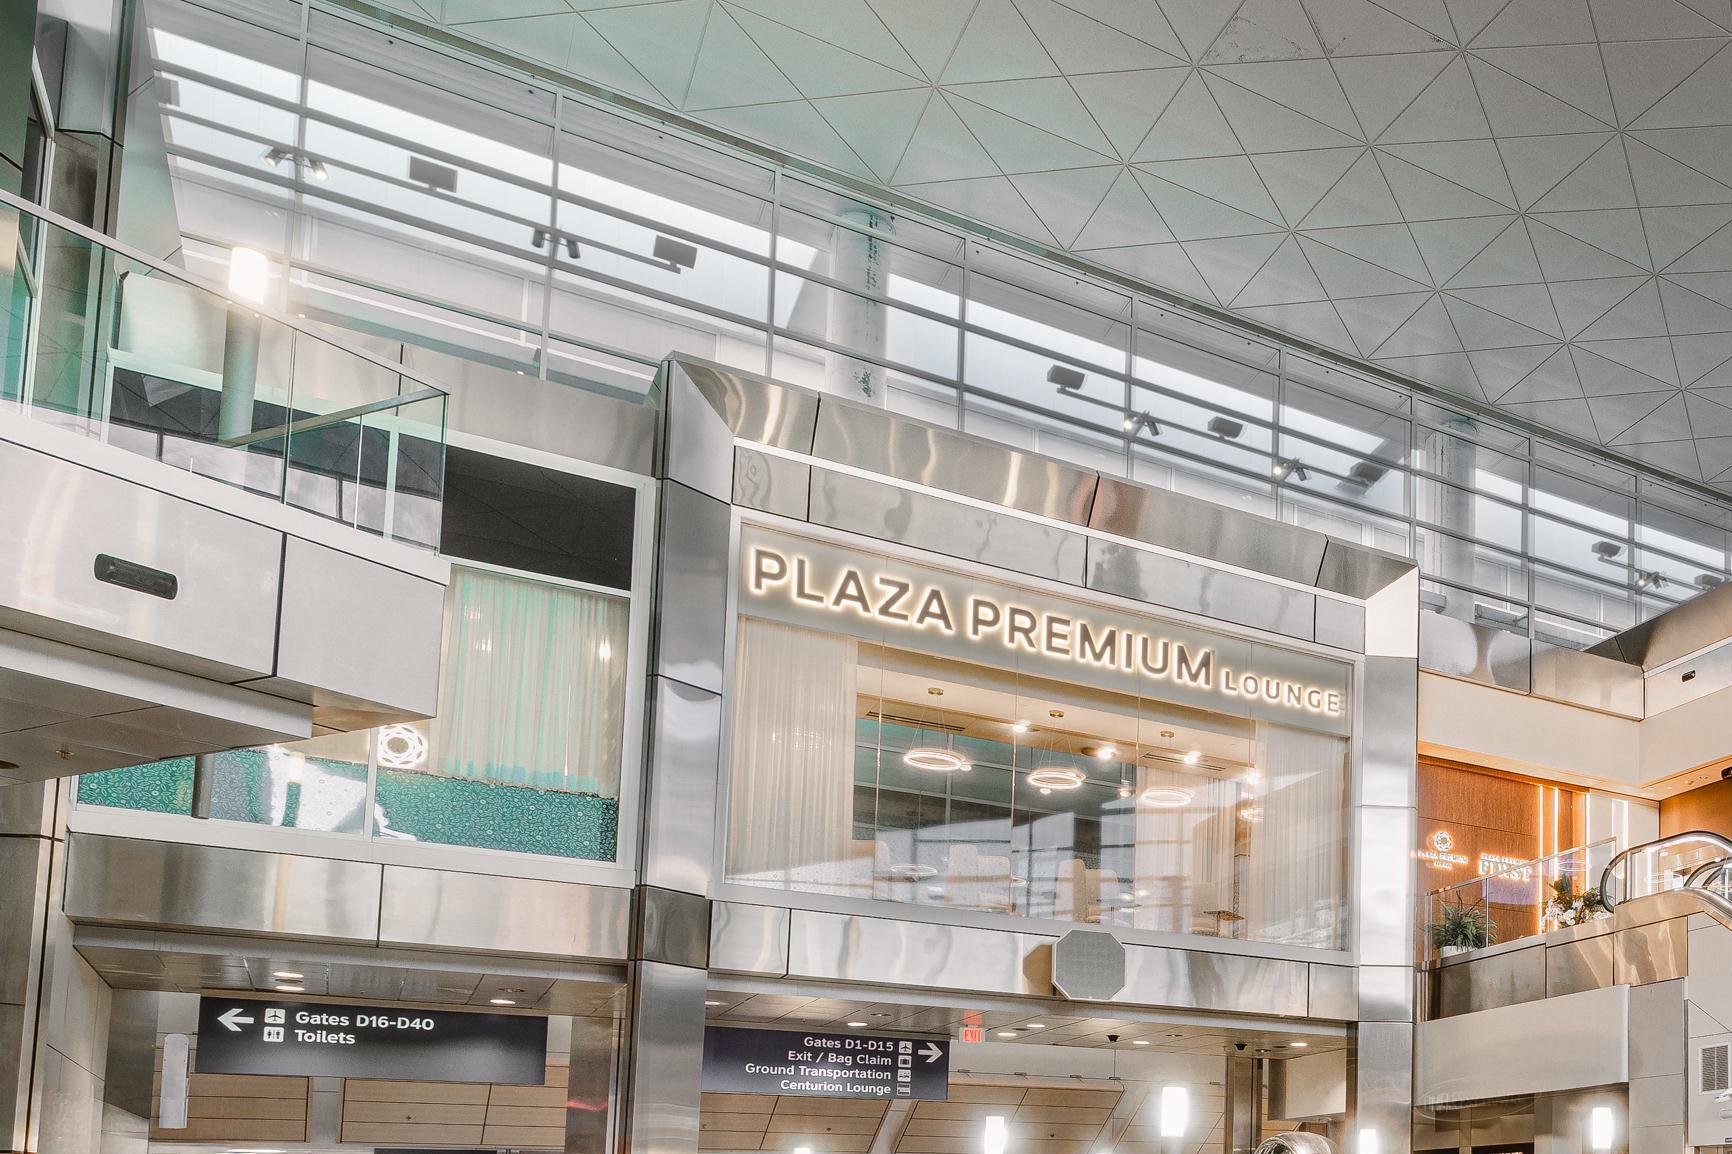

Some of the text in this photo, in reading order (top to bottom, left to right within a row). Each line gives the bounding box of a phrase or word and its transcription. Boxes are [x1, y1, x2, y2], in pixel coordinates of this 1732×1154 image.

[753, 547, 1340, 714] PLAZA PREMIUM LOUNGE
[1479, 860, 1531, 880] FIRST
[295, 1011, 435, 1031] Gates D16-D40
[294, 1029, 356, 1045] Toilets
[803, 1036, 894, 1051] Gates D1-D15
[964, 1029, 982, 1042] EXIT
[788, 1051, 892, 1066] Exit / Bag Claim
[745, 1063, 892, 1080] Ground Transportation
[780, 1079, 891, 1095] Centurion Lounge
